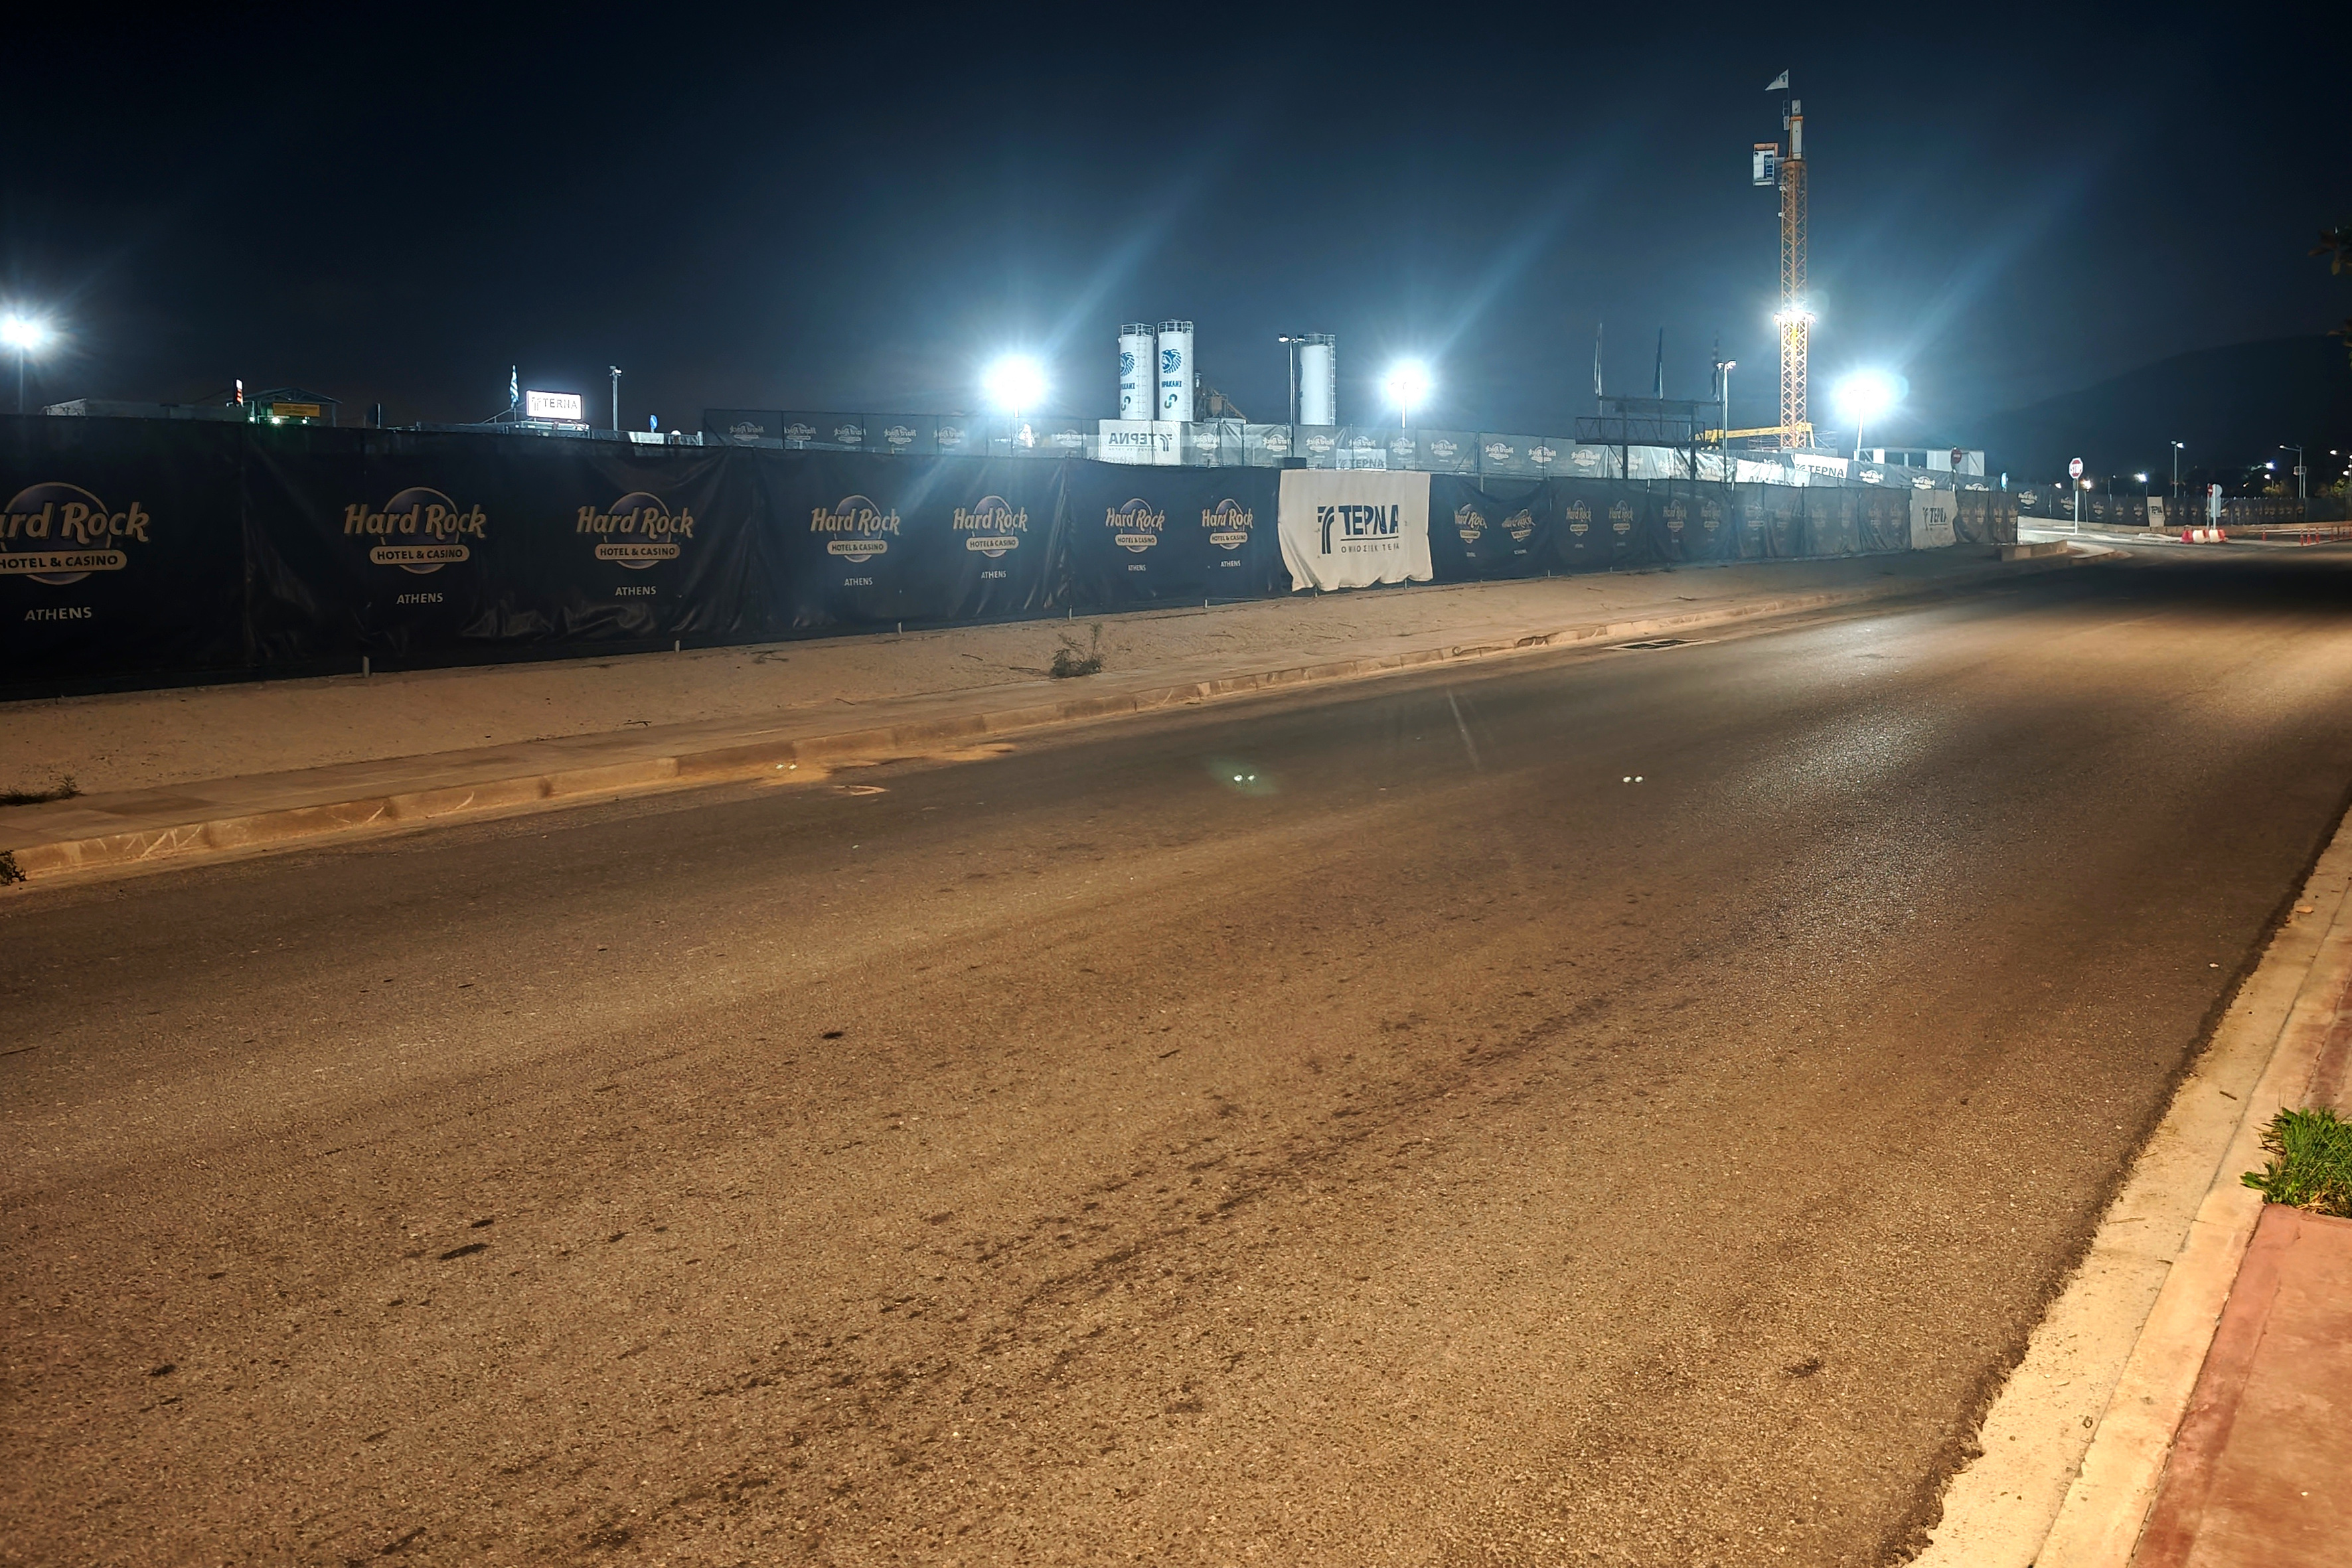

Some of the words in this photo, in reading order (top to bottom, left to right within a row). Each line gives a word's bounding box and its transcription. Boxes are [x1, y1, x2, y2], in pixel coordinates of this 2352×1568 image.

[543, 398, 578, 409] TERNA
[1808, 465, 1844, 477] ΤΕΡΝΑ
[60, 501, 150, 543] Rock
[343, 503, 420, 535] Hard
[425, 504, 487, 540] Rock
[576, 506, 640, 534] Hard
[640, 507, 694, 540] Rock
[811, 507, 857, 532] Hard
[858, 509, 901, 536] Rock
[953, 507, 993, 530] Hard
[994, 507, 1028, 534] Rock
[1105, 507, 1136, 527] Hard
[1136, 509, 1166, 532] Rock
[1202, 509, 1228, 528] Hard
[1229, 507, 1253, 530] Rock
[1338, 505, 1399, 535] ΤΕΡΝΑ
[50, 557, 61, 567] &
[66, 556, 118, 566] CASINO
[377, 550, 414, 560] HOTEL
[416, 550, 424, 559] &
[427, 549, 463, 559] CASINO
[844, 578, 874, 586] ATHENS
[981, 570, 1006, 579] ATHENS
[615, 586, 657, 596] ATHENS
[396, 593, 443, 605] ATHENS
[25, 606, 92, 621] ATHENS
